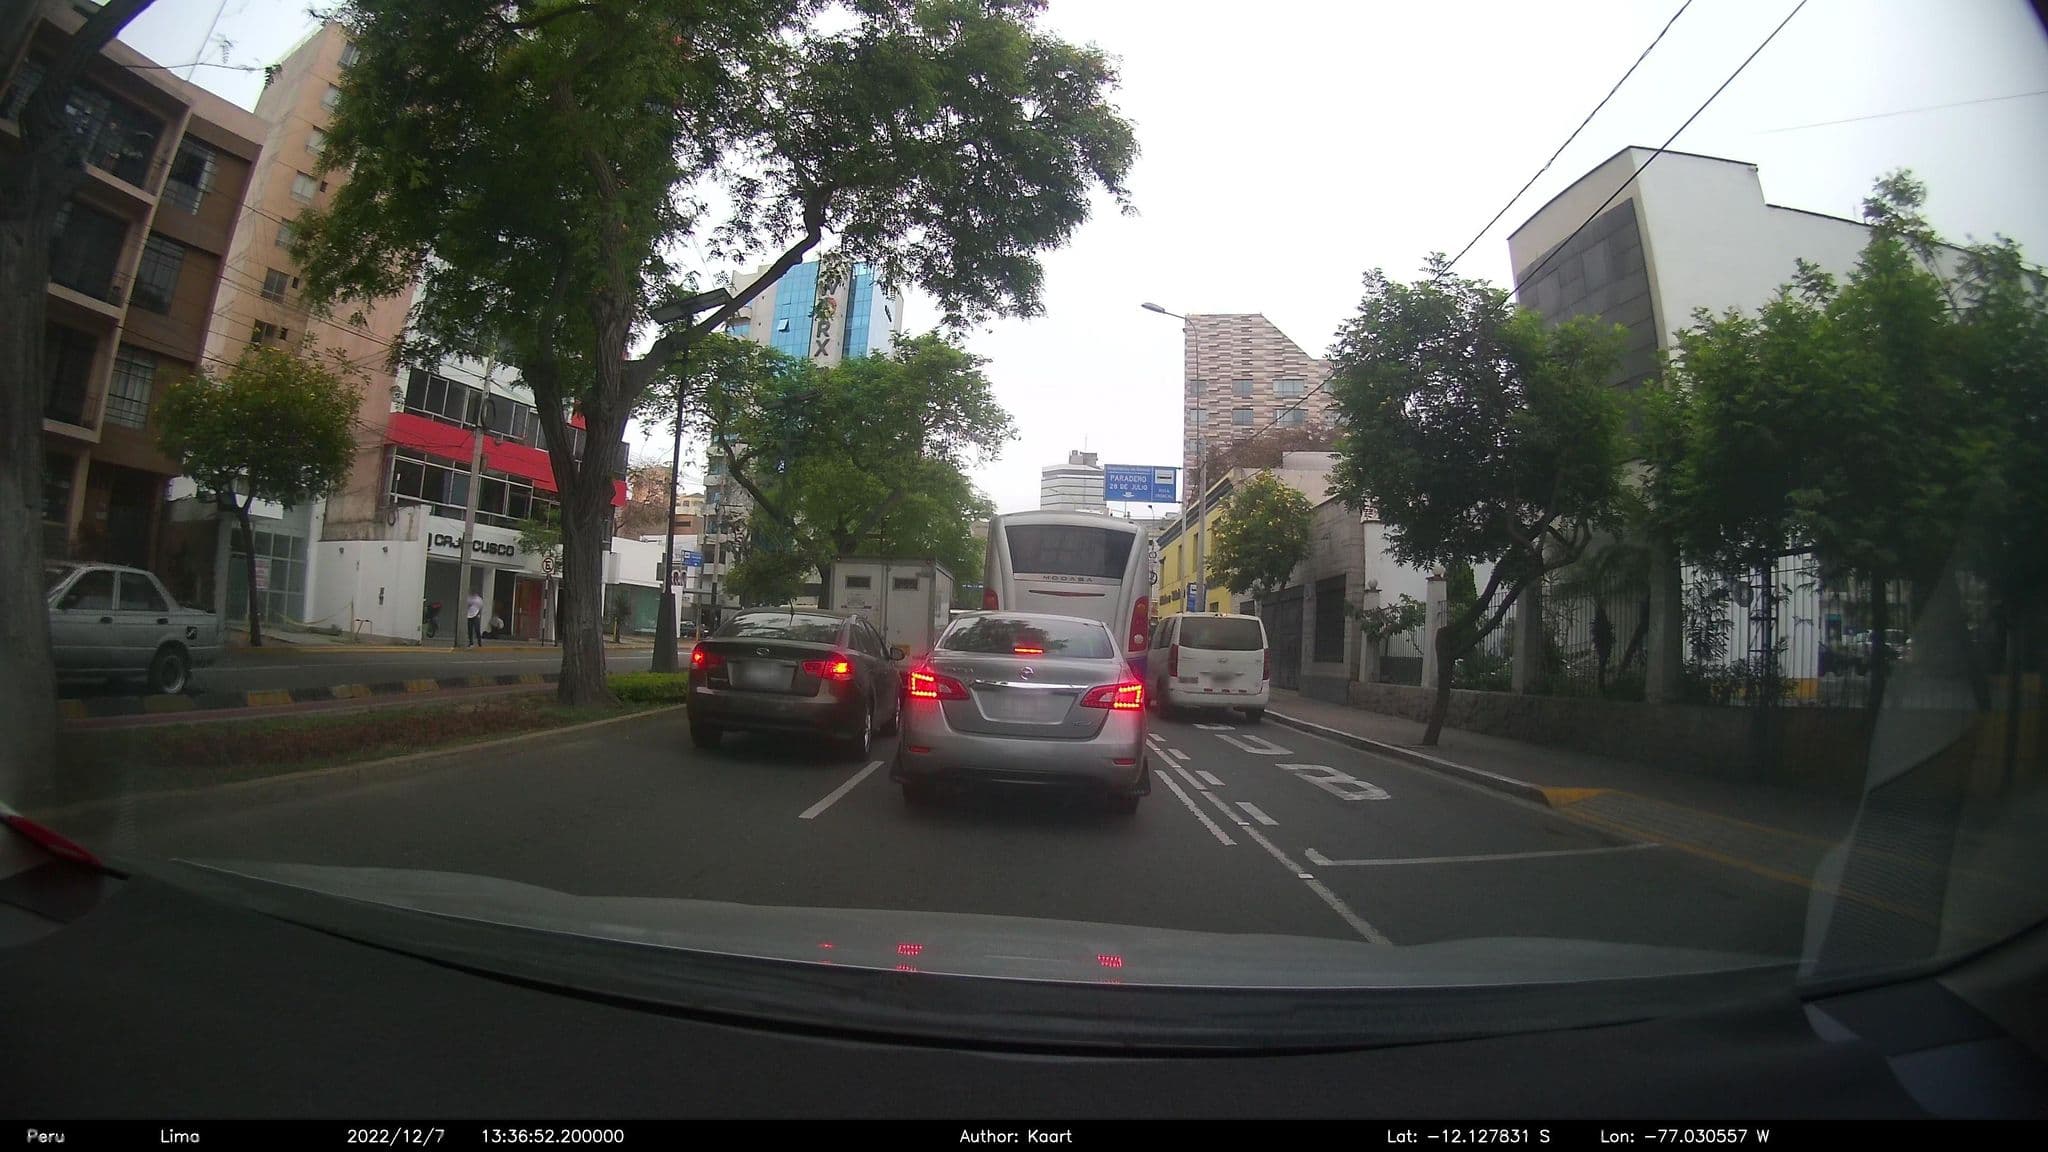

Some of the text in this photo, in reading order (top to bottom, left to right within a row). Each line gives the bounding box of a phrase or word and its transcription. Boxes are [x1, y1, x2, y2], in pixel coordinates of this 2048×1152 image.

[1110, 474, 1147, 482] PARADERO
[472, 540, 515, 556] CUSCO
[1042, 575, 1093, 583] MODASA
